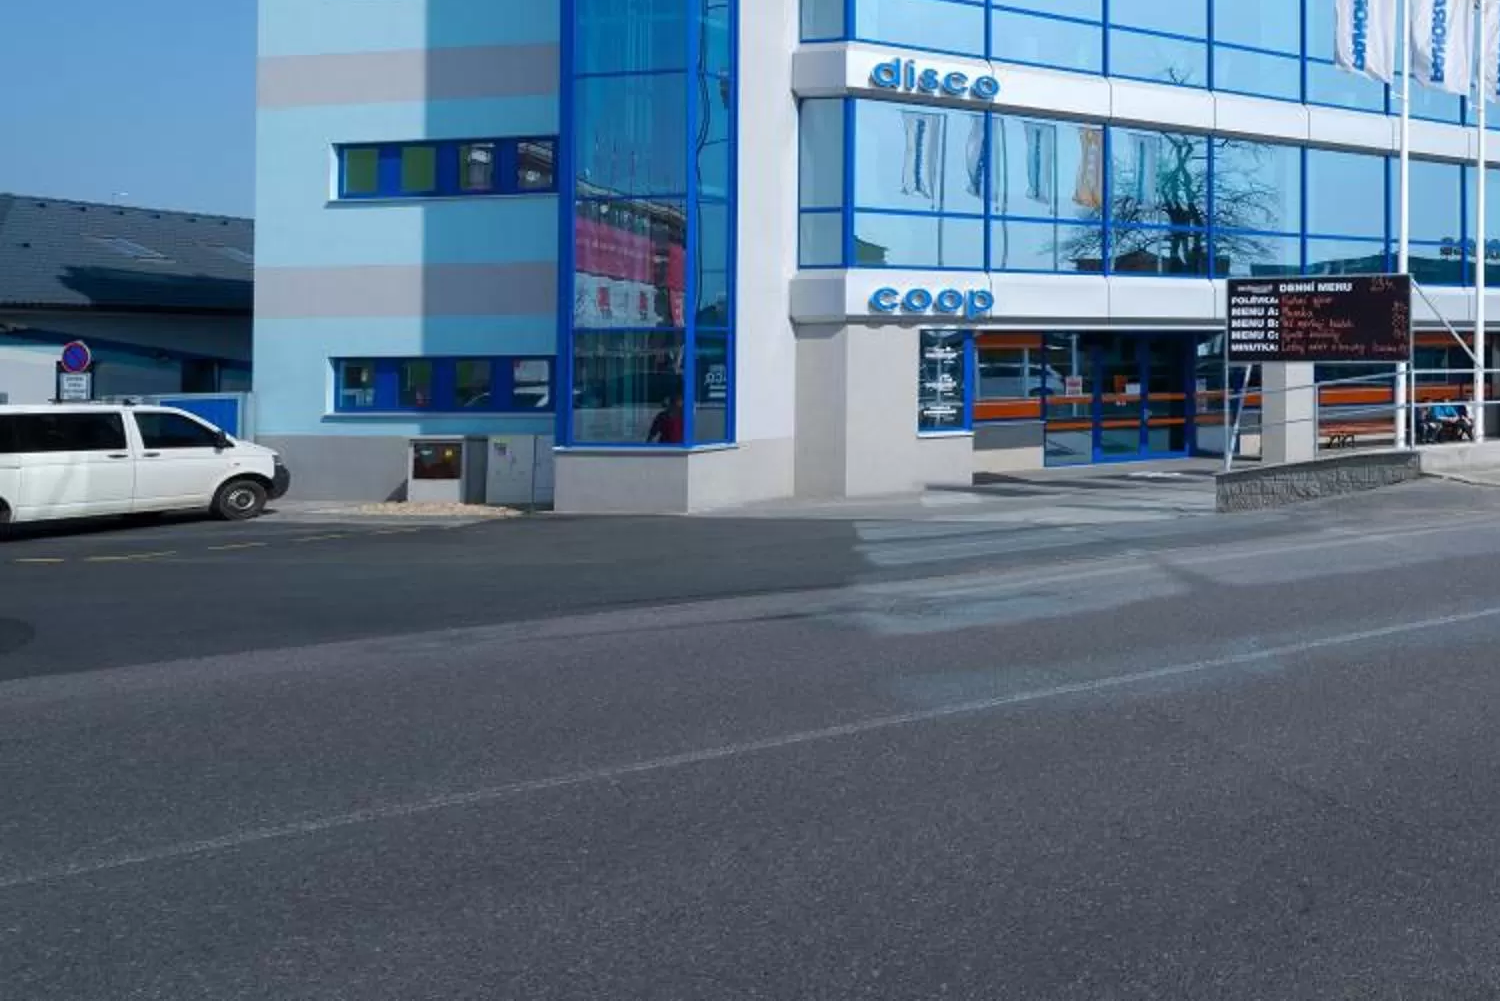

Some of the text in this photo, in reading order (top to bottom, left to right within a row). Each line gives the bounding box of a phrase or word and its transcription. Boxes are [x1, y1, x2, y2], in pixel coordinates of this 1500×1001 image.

[869, 56, 1000, 99] disco
[868, 286, 995, 320] coop
[1317, 282, 1353, 292] MENU
